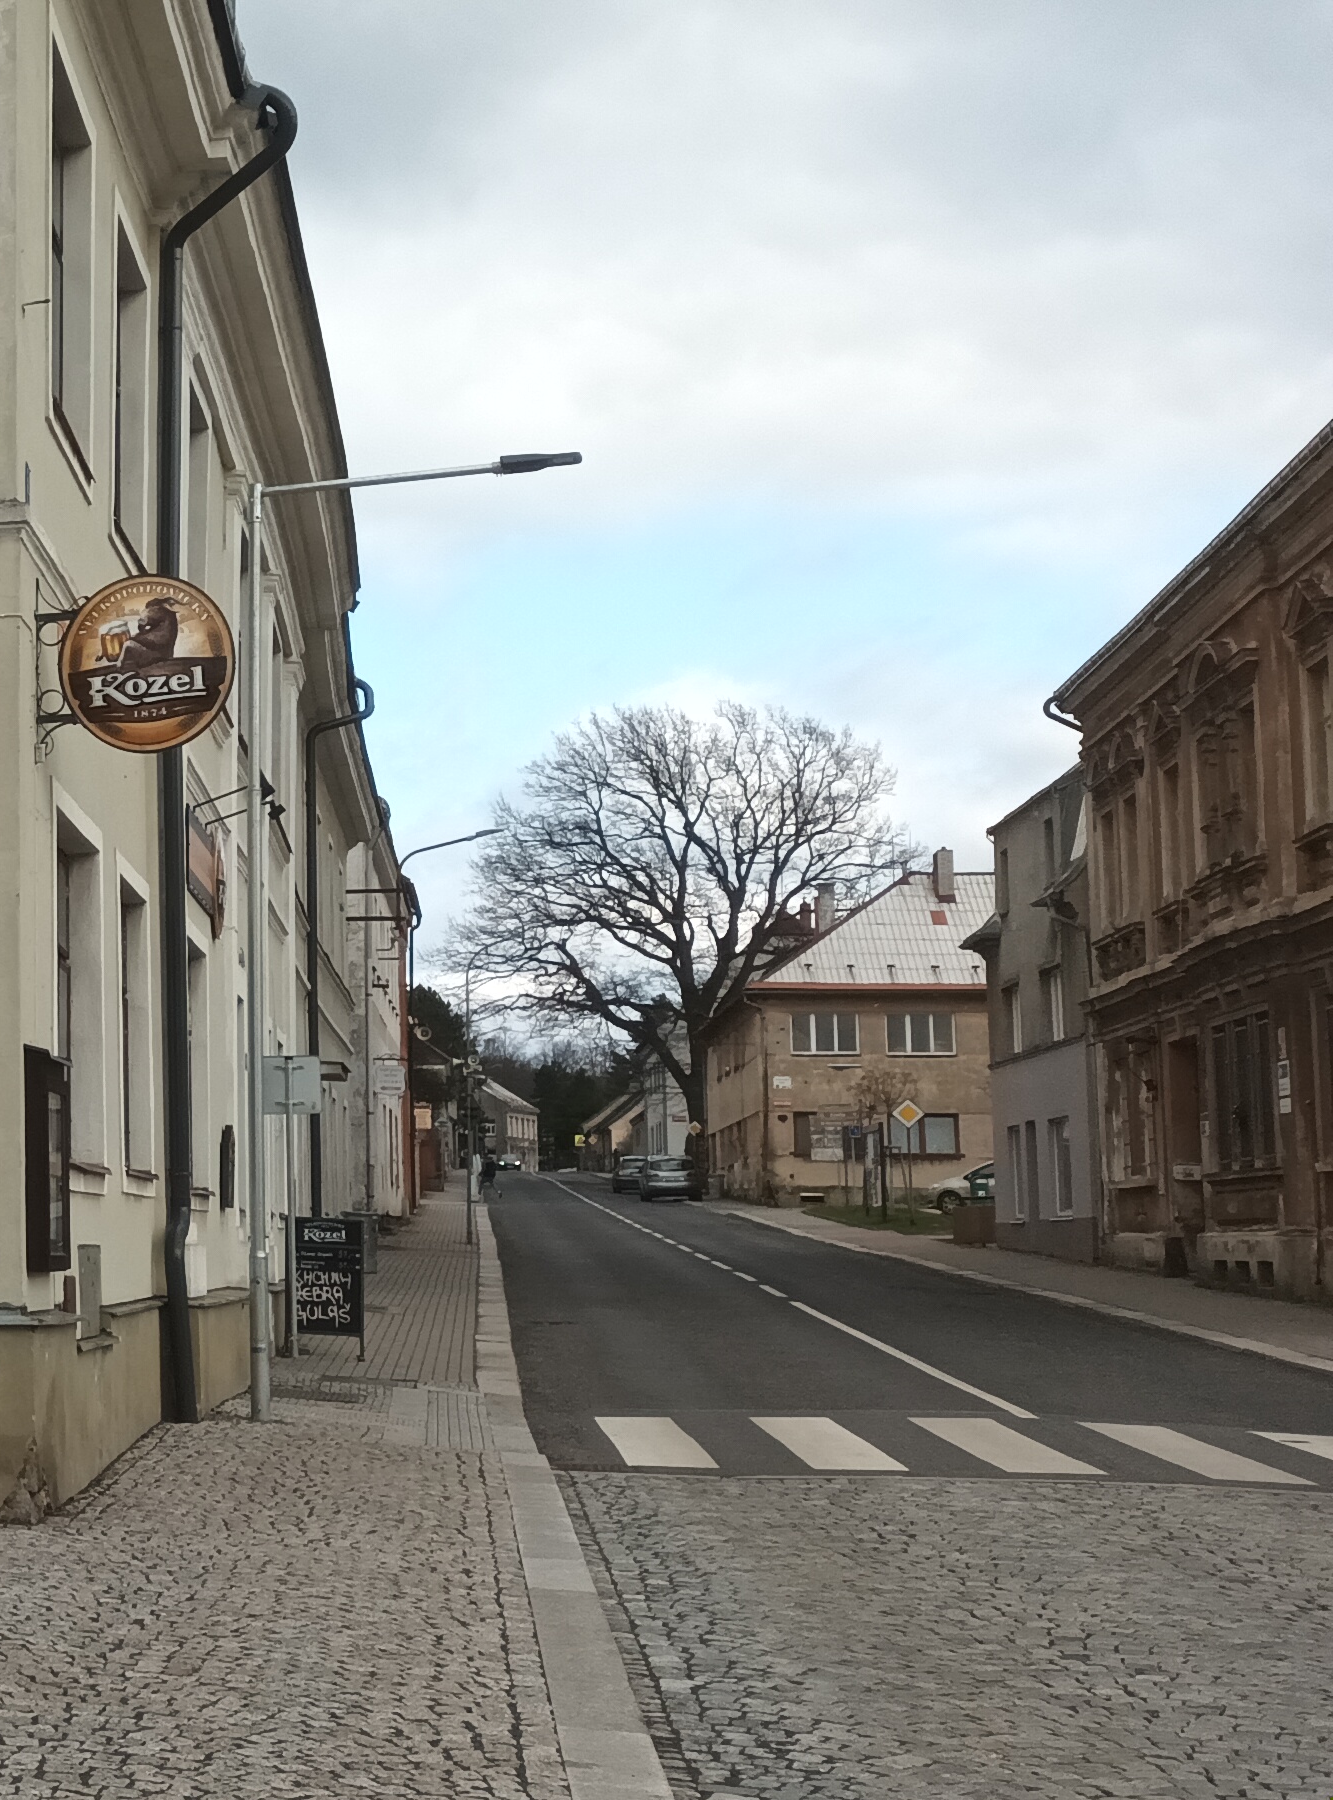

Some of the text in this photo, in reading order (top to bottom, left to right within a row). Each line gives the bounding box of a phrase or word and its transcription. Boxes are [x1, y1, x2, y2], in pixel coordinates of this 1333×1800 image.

[86, 665, 207, 708] Kozel
[133, 706, 168, 718] 1874
[303, 1228, 347, 1243] Kozel
